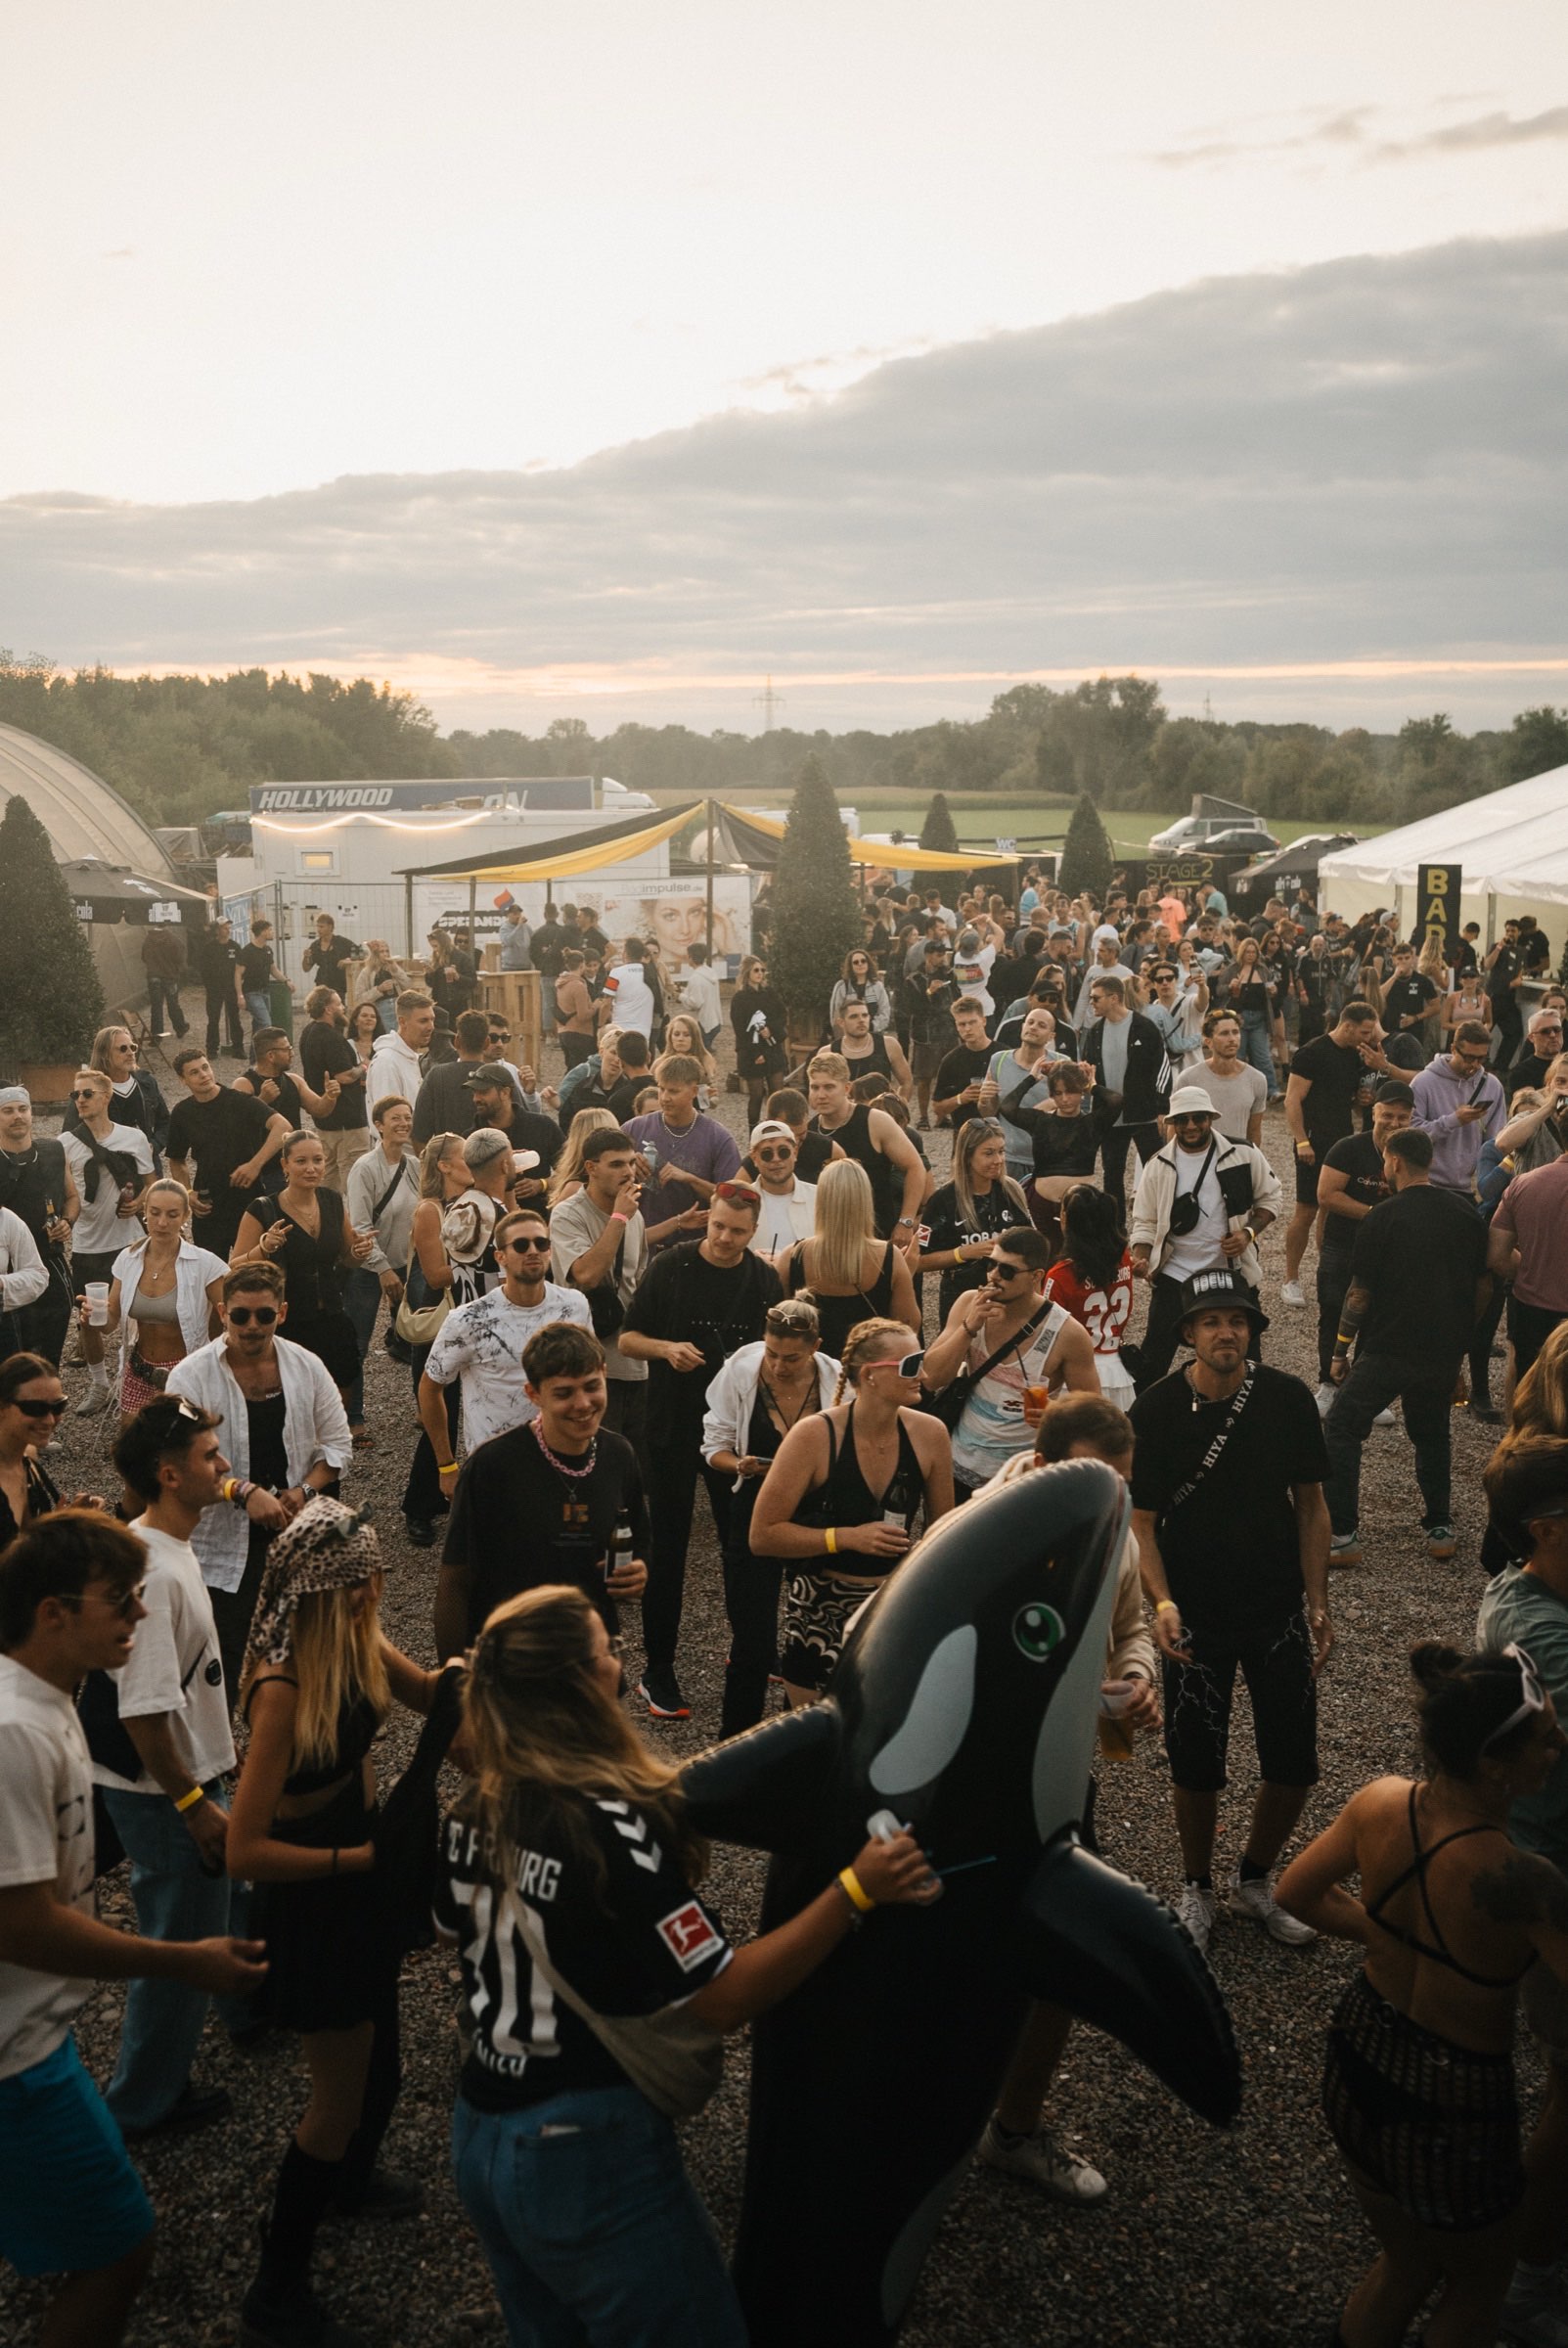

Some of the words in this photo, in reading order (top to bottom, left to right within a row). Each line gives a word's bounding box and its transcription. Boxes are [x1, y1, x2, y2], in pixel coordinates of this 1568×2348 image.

[258, 788, 393, 809] HOLLYWOOD
[996, 837, 1016, 849] WC
[1145, 862, 1201, 879] STAGE
[1201, 858, 1214, 878] 2
[1083, 1285, 1131, 1351] 32
[1202, 1434, 1228, 1468] HIYA
[1232, 1378, 1254, 1414] HIYA
